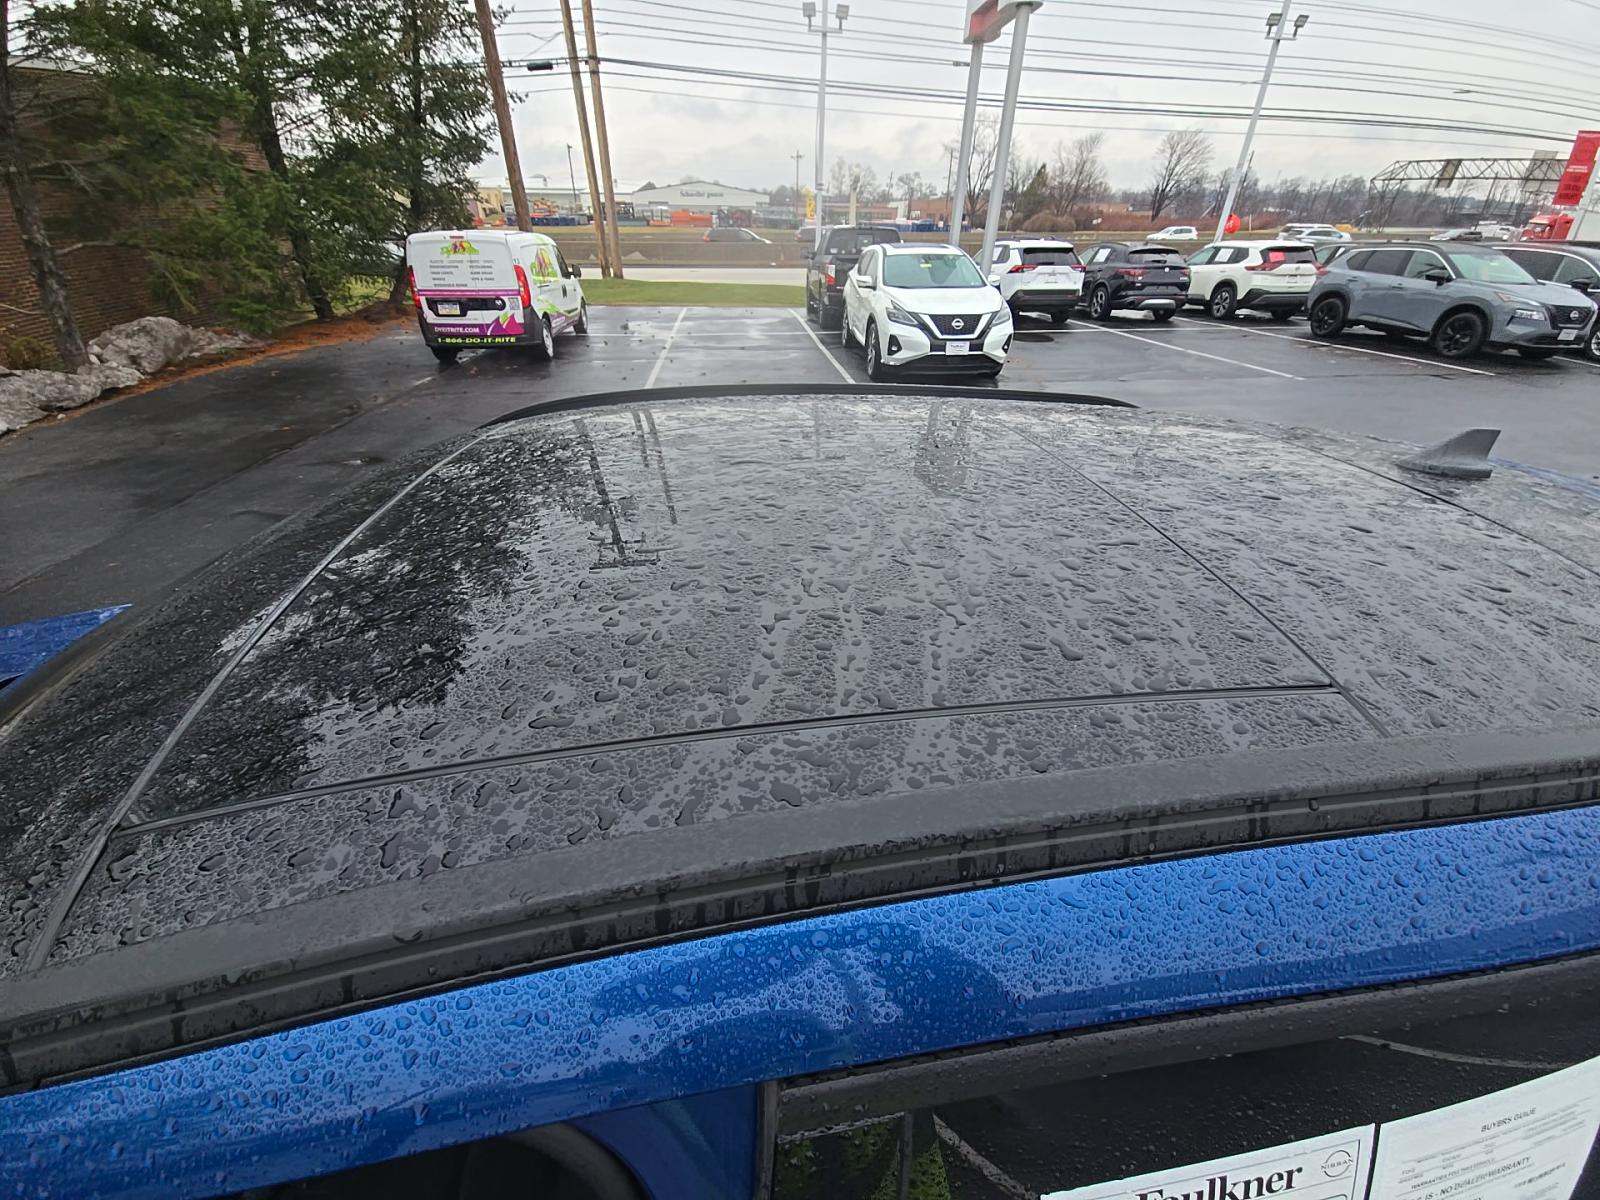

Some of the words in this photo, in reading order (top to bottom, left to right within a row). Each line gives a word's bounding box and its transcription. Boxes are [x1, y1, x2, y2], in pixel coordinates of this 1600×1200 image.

[1480, 1115, 1513, 1133] BUYERS
[1513, 1107, 1537, 1122] GUIDE
[1320, 1157, 1354, 1171] NISSAN
[1135, 1166, 1303, 1200] Flkner
